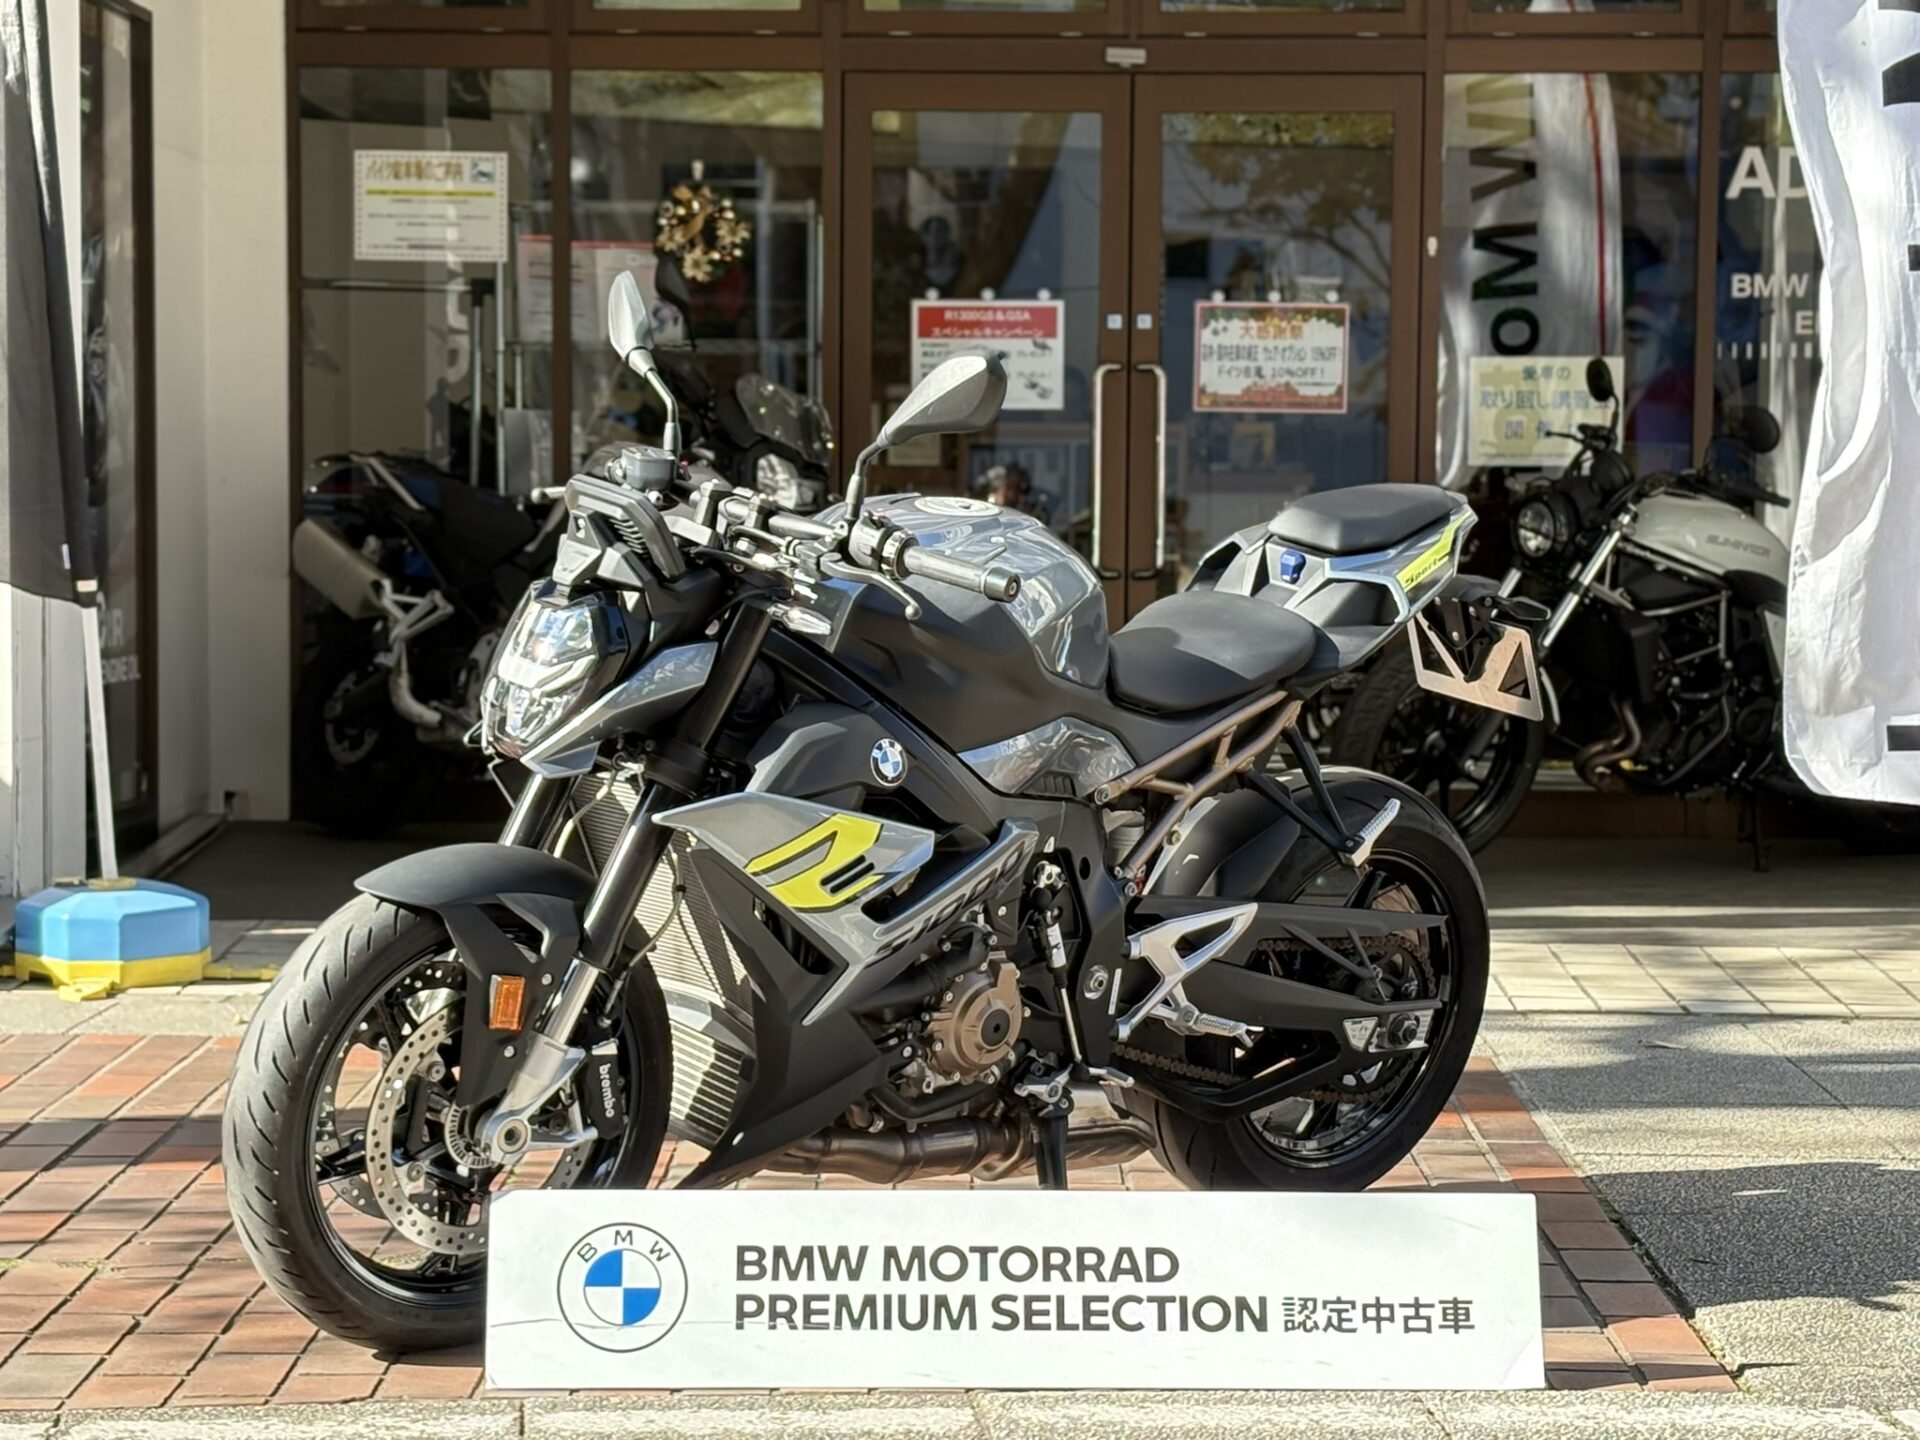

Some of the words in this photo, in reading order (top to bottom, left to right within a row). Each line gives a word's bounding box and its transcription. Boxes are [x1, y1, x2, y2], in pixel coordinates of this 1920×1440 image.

[1731, 272, 1810, 299] BMW
[1795, 310, 1820, 335] E
[1480, 390, 1612, 410] 取り回し講習
[598, 1062, 617, 1119] brembo
[577, 1229, 673, 1263] BMW
[736, 1245, 869, 1282] BMW
[882, 1244, 1180, 1283] MOTORRAD
[735, 1294, 977, 1331] PREMIUM
[991, 1294, 1269, 1333] SELECTION
[1281, 1295, 1476, 1334] 認定中古車
